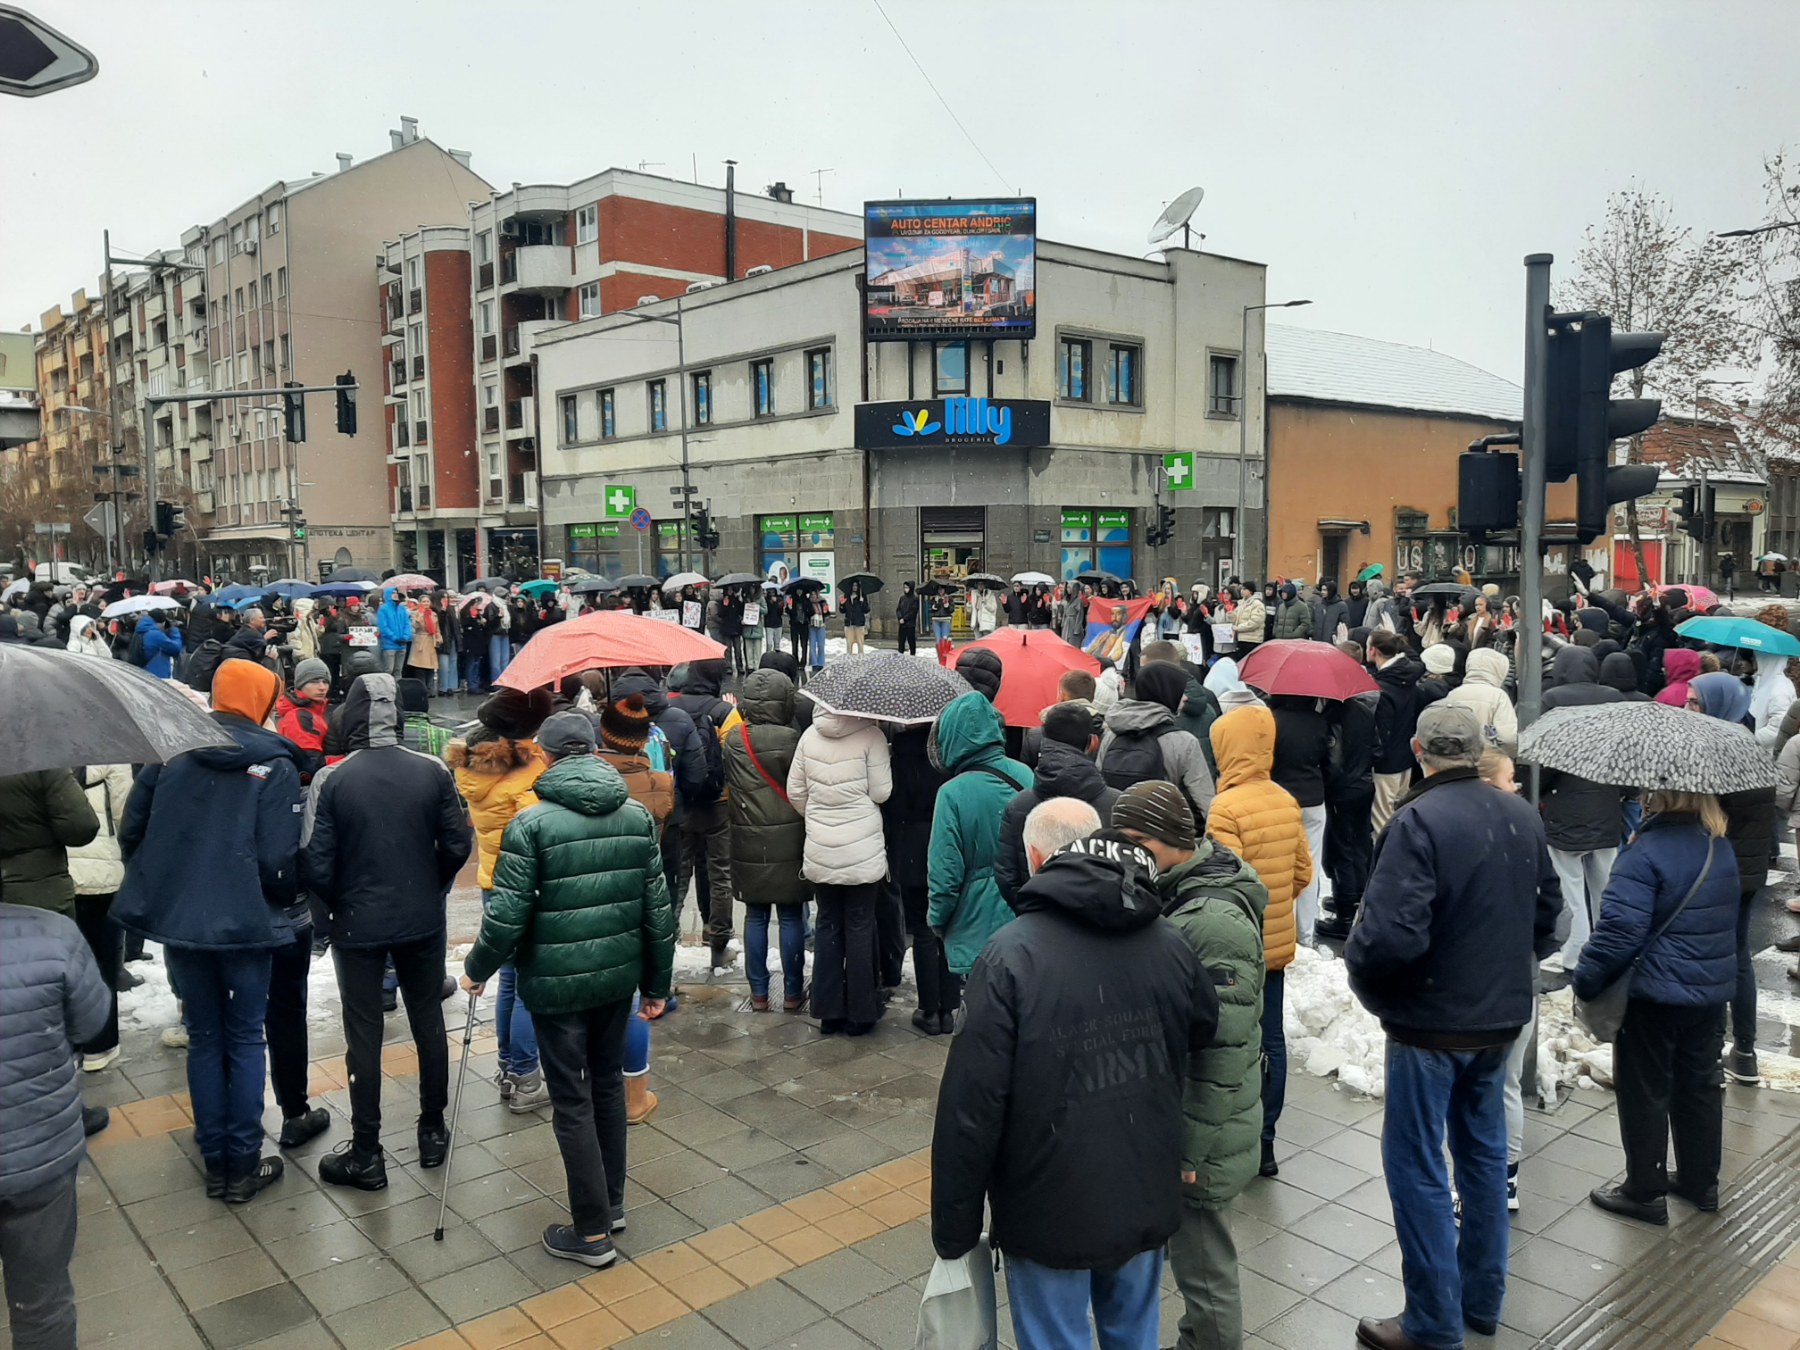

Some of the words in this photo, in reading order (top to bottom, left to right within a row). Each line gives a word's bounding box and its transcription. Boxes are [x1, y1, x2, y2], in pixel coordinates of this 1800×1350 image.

[891, 218, 921, 230] AUTO
[924, 217, 968, 229] CENTAR
[944, 396, 1011, 445] lilly
[1064, 1039, 1169, 1094] ARMY
